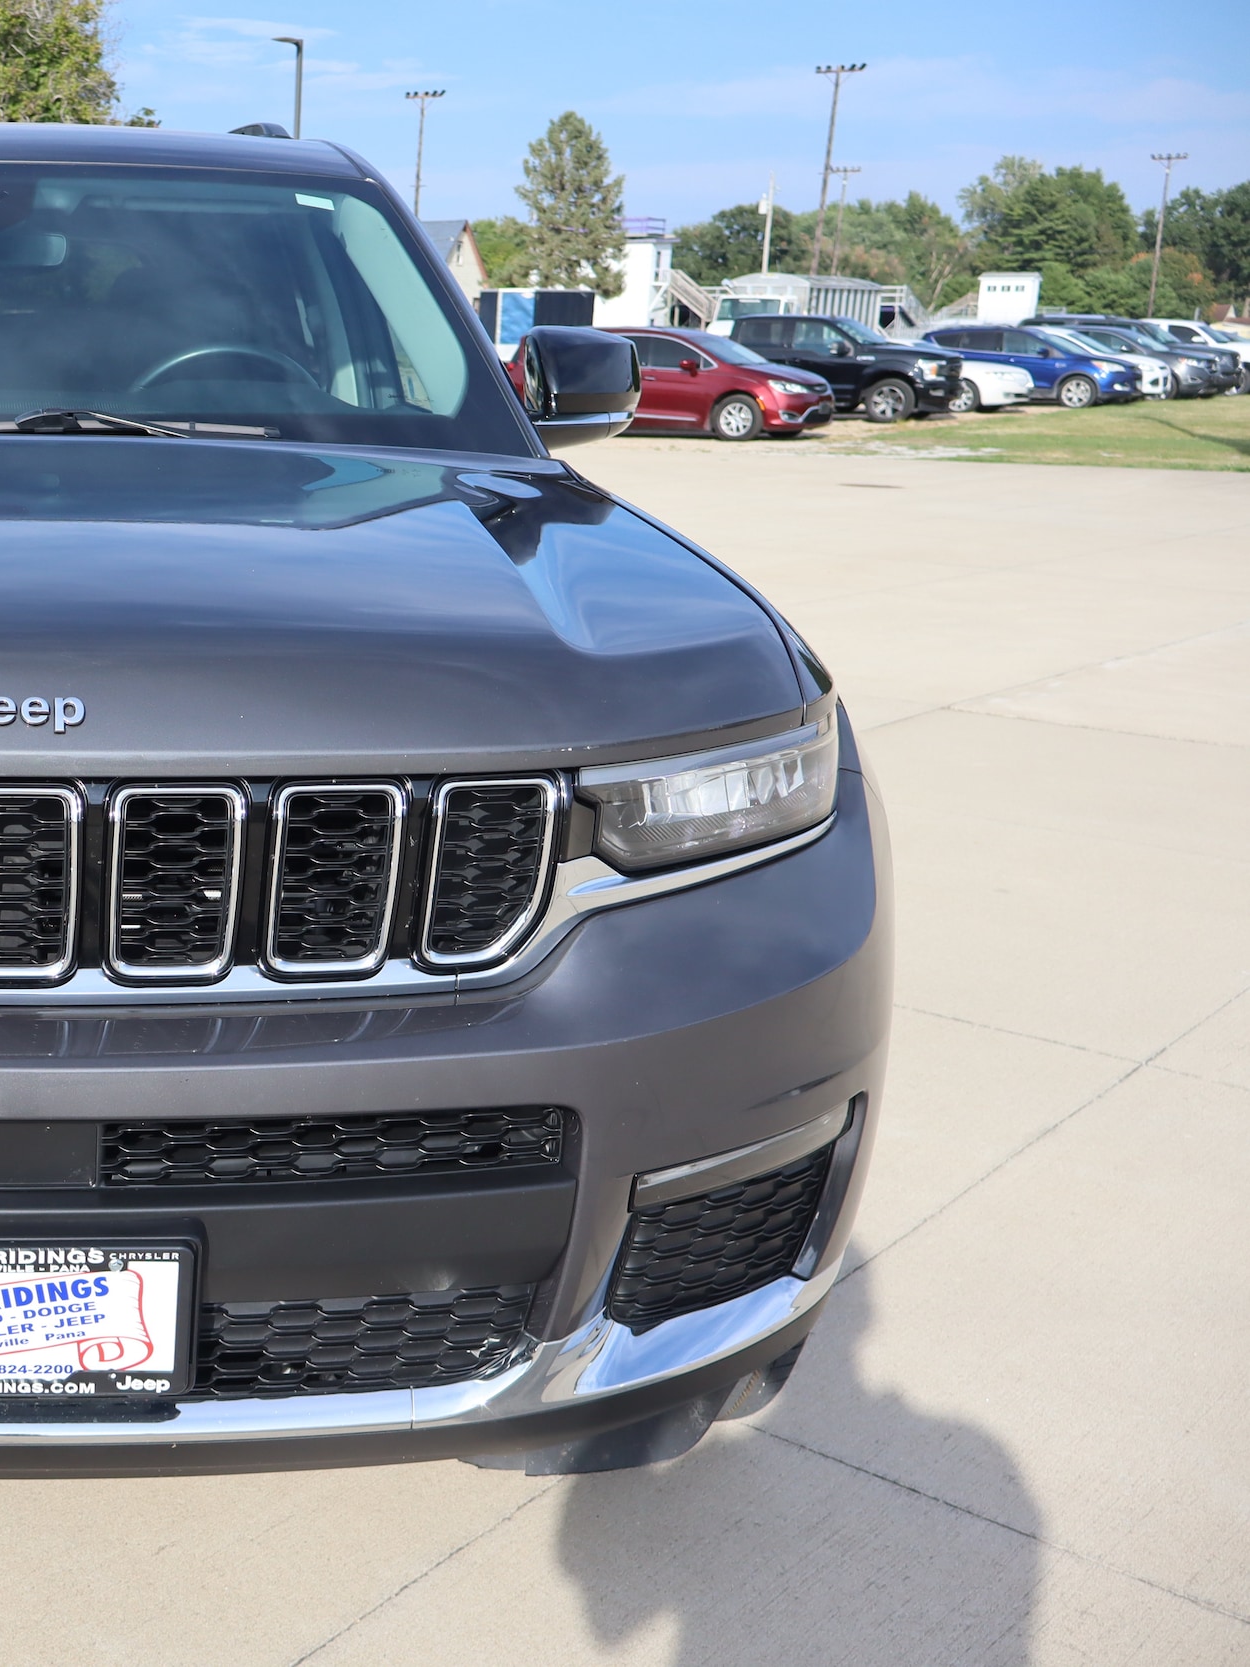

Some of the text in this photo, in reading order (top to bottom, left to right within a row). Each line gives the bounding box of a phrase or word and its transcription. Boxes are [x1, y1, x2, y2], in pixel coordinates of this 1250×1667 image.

[109, 1252, 180, 1260] CHRYSLER
[50, 1264, 92, 1273] PANA
[23, 1301, 97, 1319] DODGE
[54, 1313, 106, 1329] JEEP
[45, 1330, 86, 1341] Pana
[116, 1374, 171, 1394] Jeep
